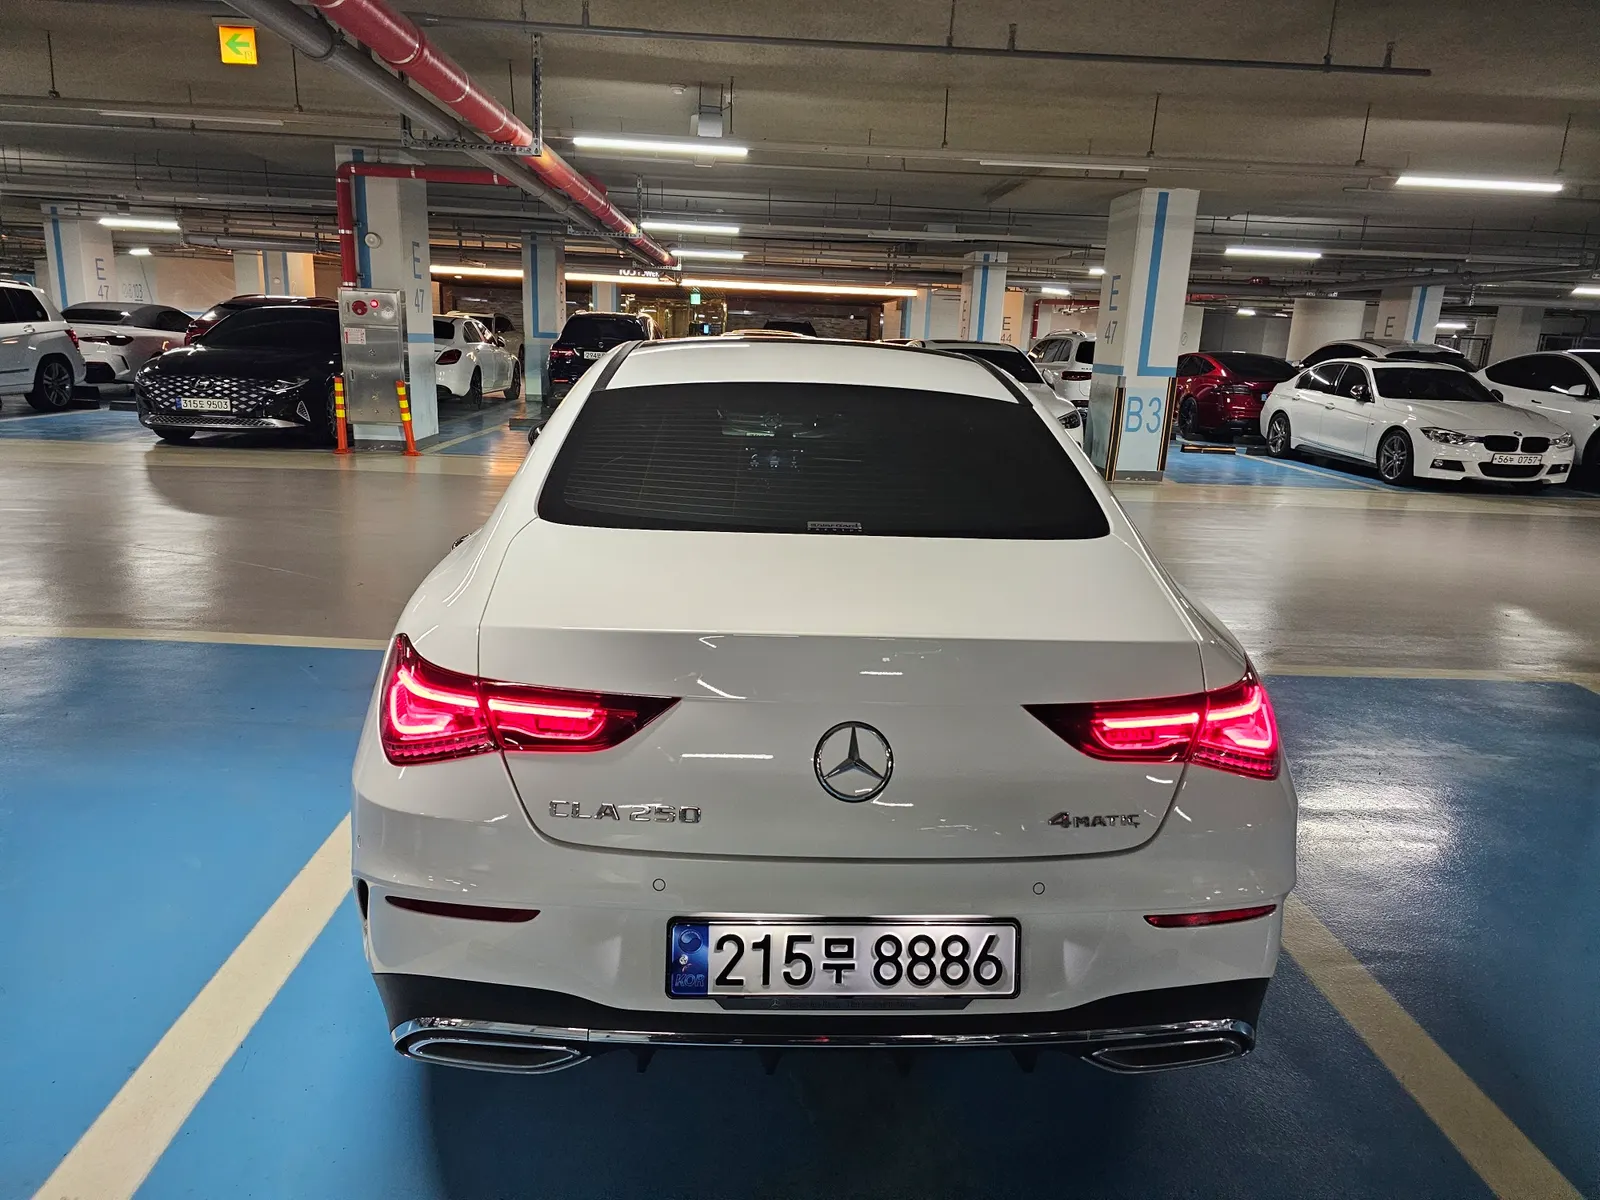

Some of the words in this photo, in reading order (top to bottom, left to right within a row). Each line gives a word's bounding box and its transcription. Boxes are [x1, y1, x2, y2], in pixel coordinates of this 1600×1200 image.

[95, 258, 106, 280] E
[411, 241, 422, 279] E
[97, 285, 109, 300] 47
[414, 288, 424, 313] 47
[1109, 275, 1121, 311] E
[1002, 316, 1011, 330] E
[1104, 320, 1118, 345] 47
[1384, 316, 1396, 337] E
[206, 400, 229, 409] 9503
[1125, 396, 1162, 434] B3
[1517, 456, 1539, 464] 0757
[549, 800, 620, 821] CLA
[629, 803, 701, 824] 250
[1048, 811, 1140, 829] 4MATIC
[714, 933, 856, 987] 215무
[873, 933, 1004, 987] 8886
[674, 973, 705, 987] KOR
